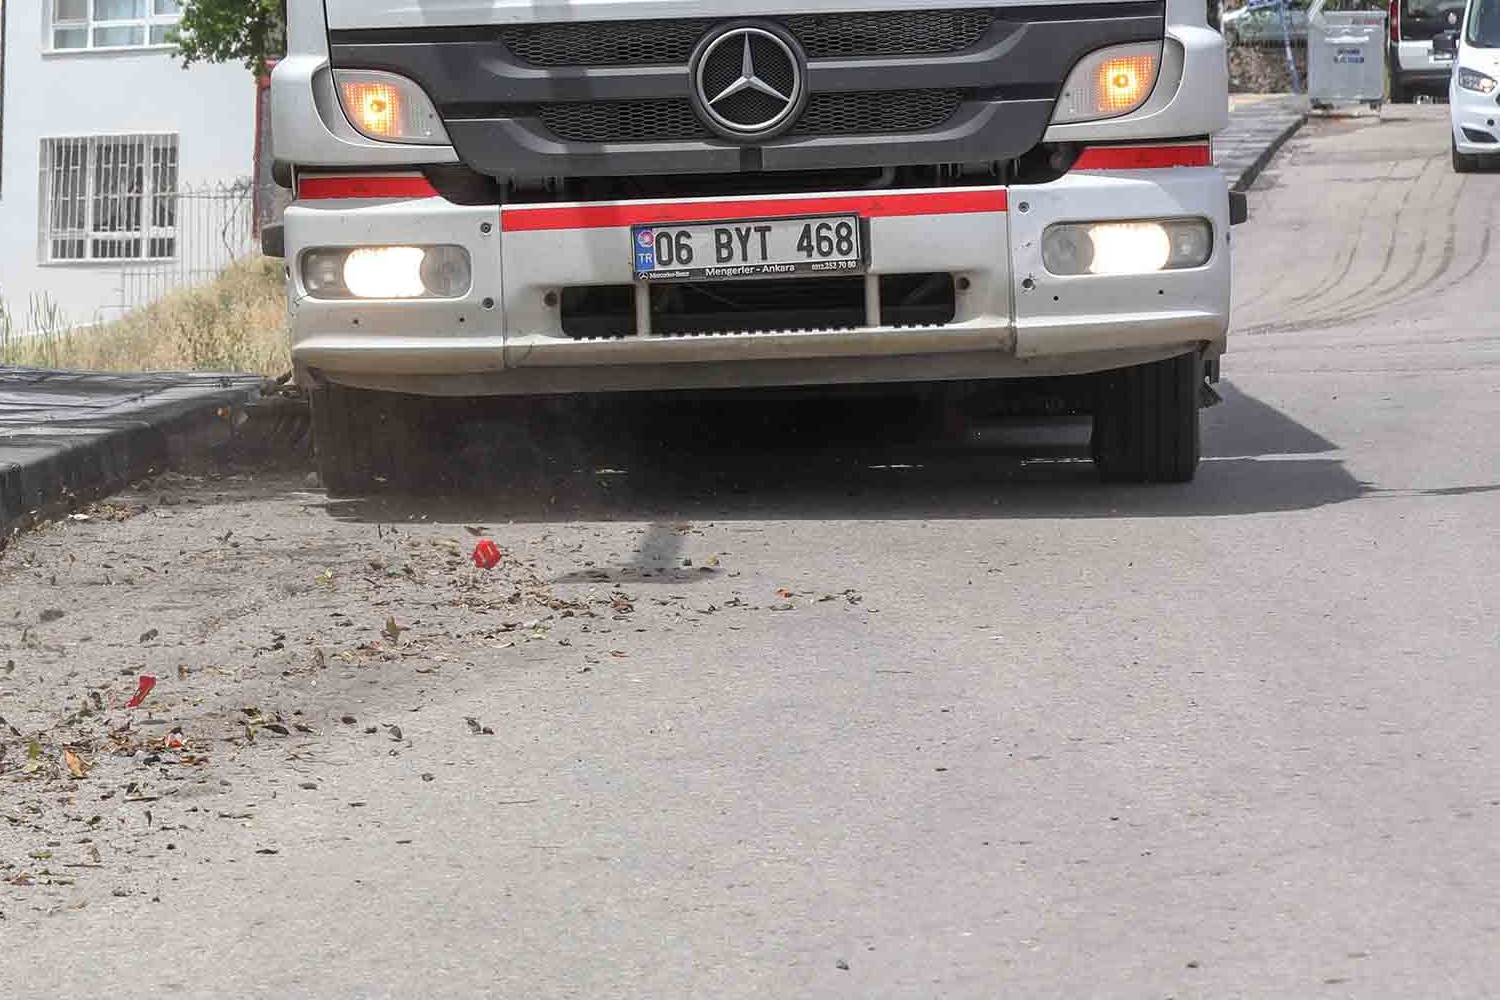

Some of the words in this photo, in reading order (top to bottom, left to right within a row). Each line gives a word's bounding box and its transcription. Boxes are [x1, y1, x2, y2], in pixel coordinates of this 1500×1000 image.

[655, 230, 693, 266] 06
[714, 225, 772, 264] BYT
[797, 221, 853, 258] 468
[638, 253, 653, 264] TR
[762, 264, 796, 273] Ankara
